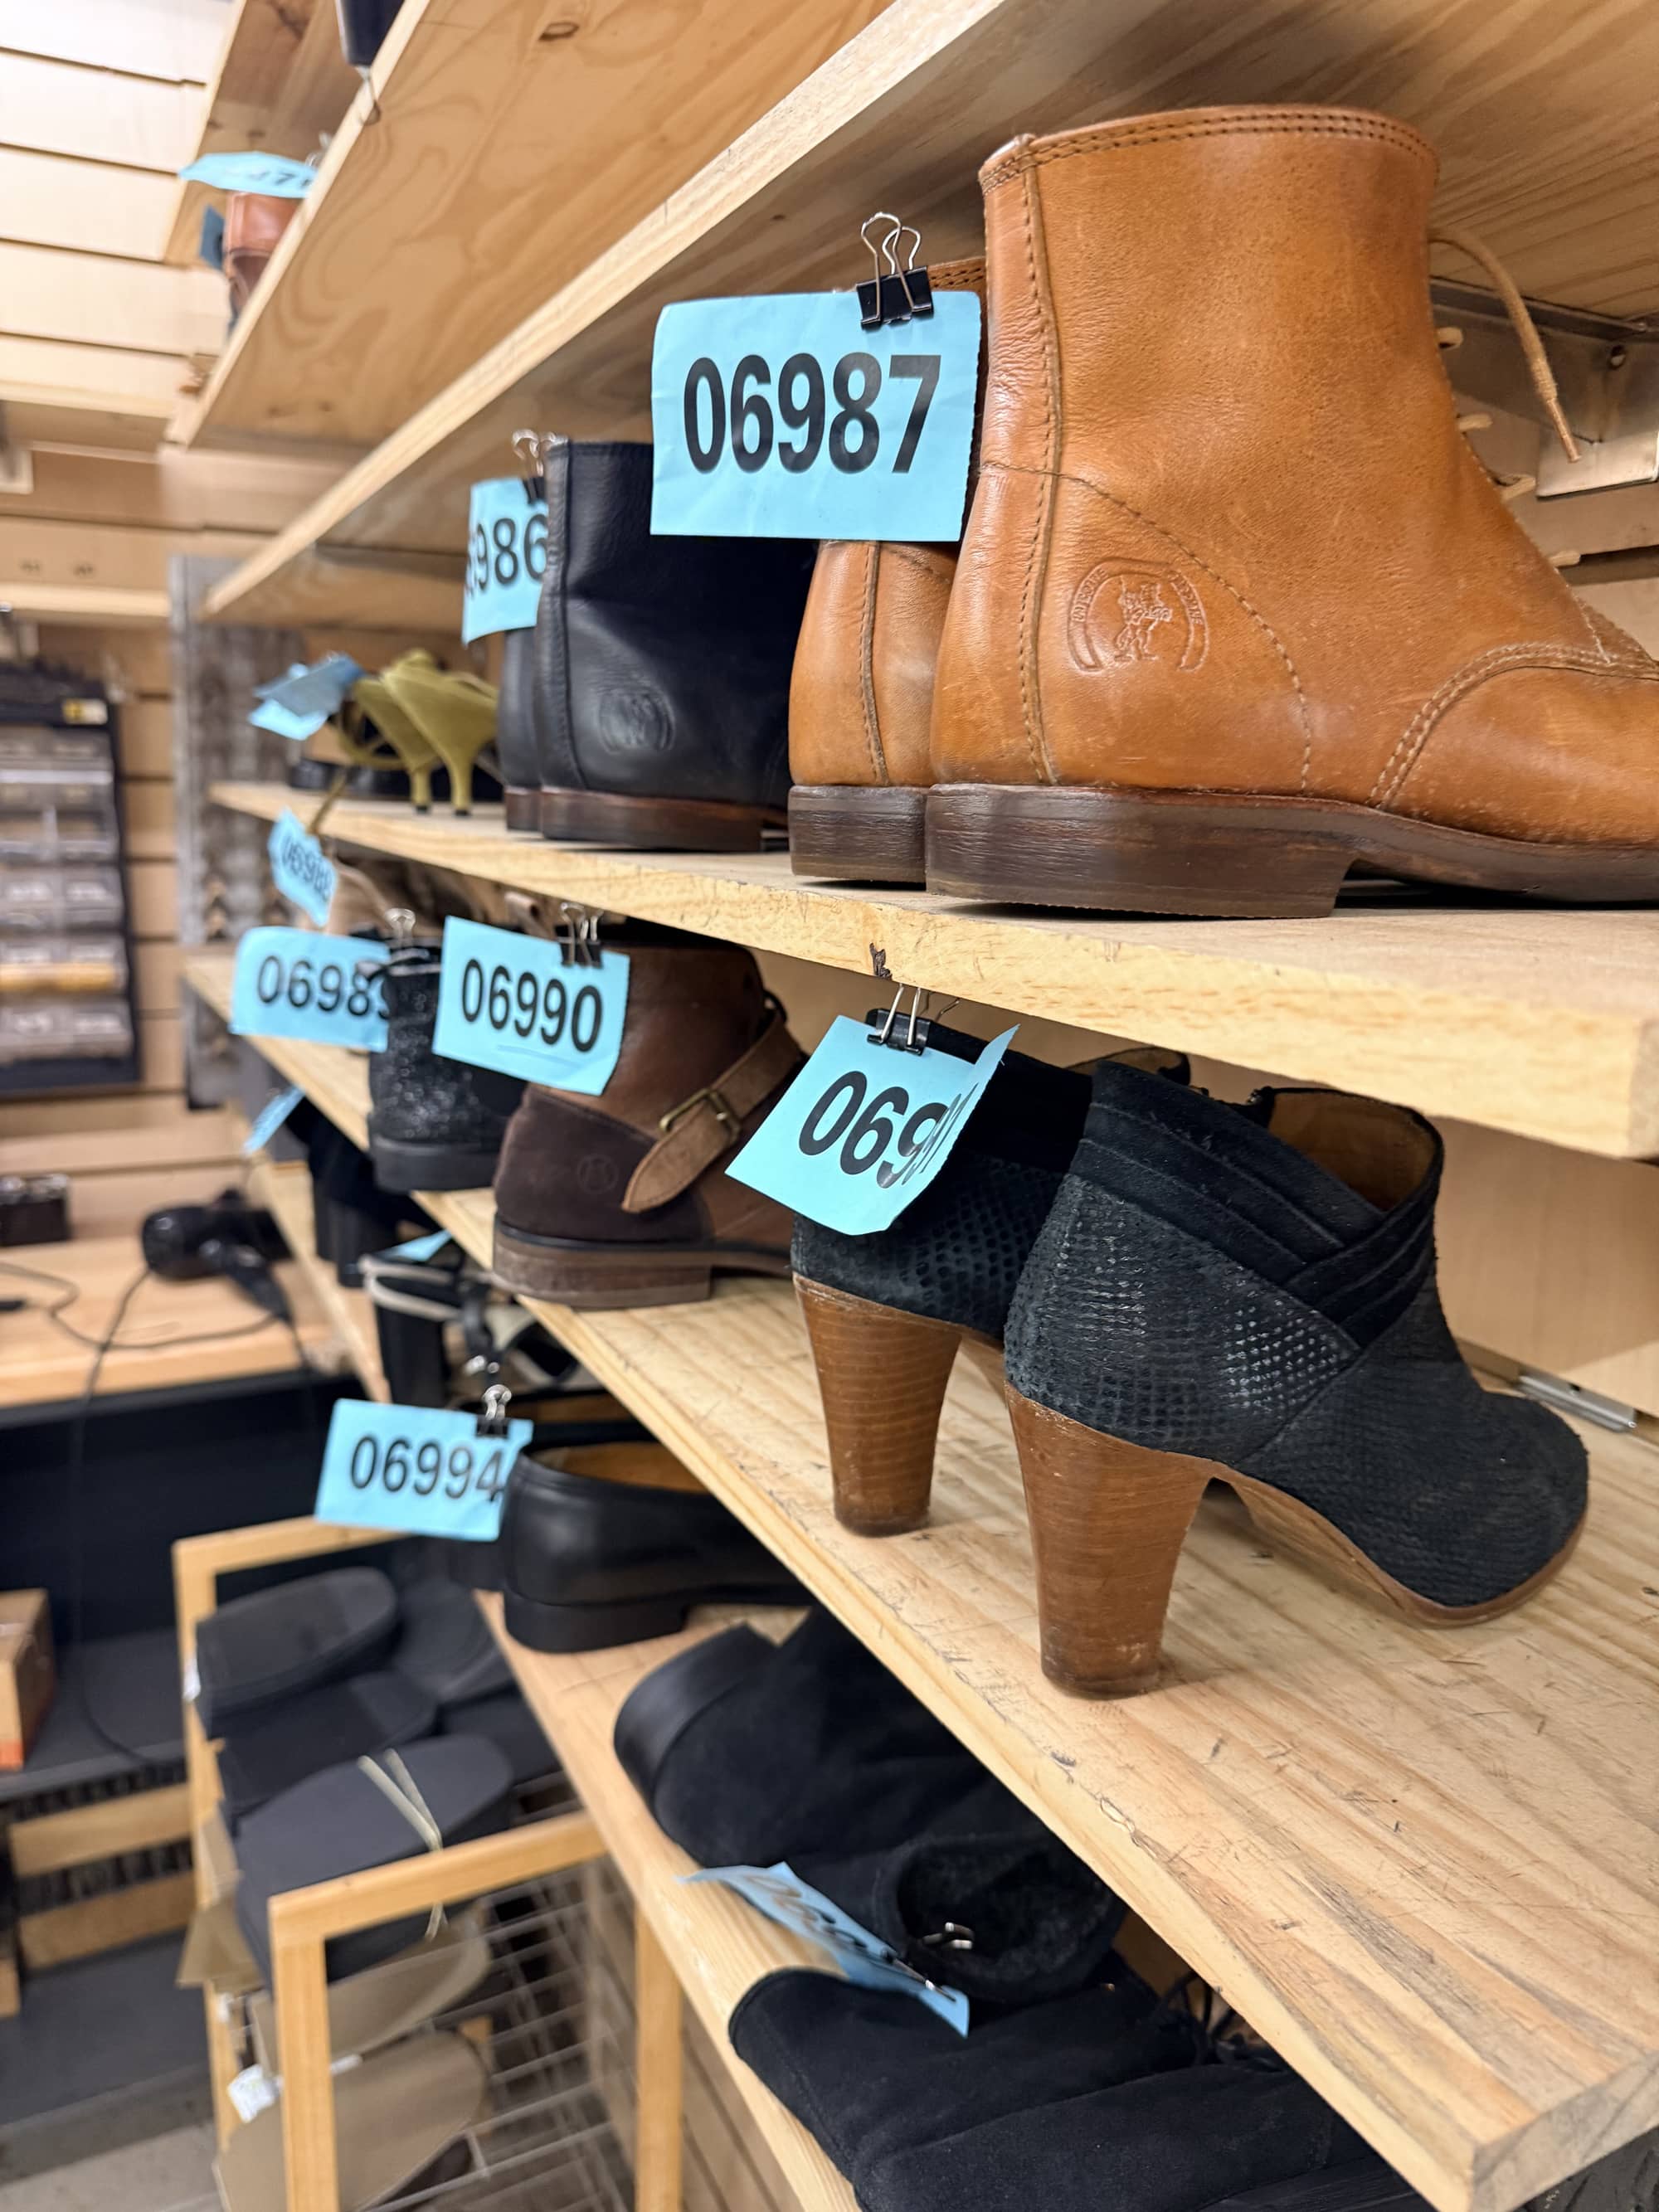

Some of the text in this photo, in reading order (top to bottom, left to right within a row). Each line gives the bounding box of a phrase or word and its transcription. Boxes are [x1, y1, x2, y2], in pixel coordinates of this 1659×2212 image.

[684, 352, 942, 474] 06987
[467, 513, 547, 597] 986
[461, 959, 604, 1053] 06990
[798, 1070, 979, 1189] 069
[351, 1435, 506, 1503] 06994
